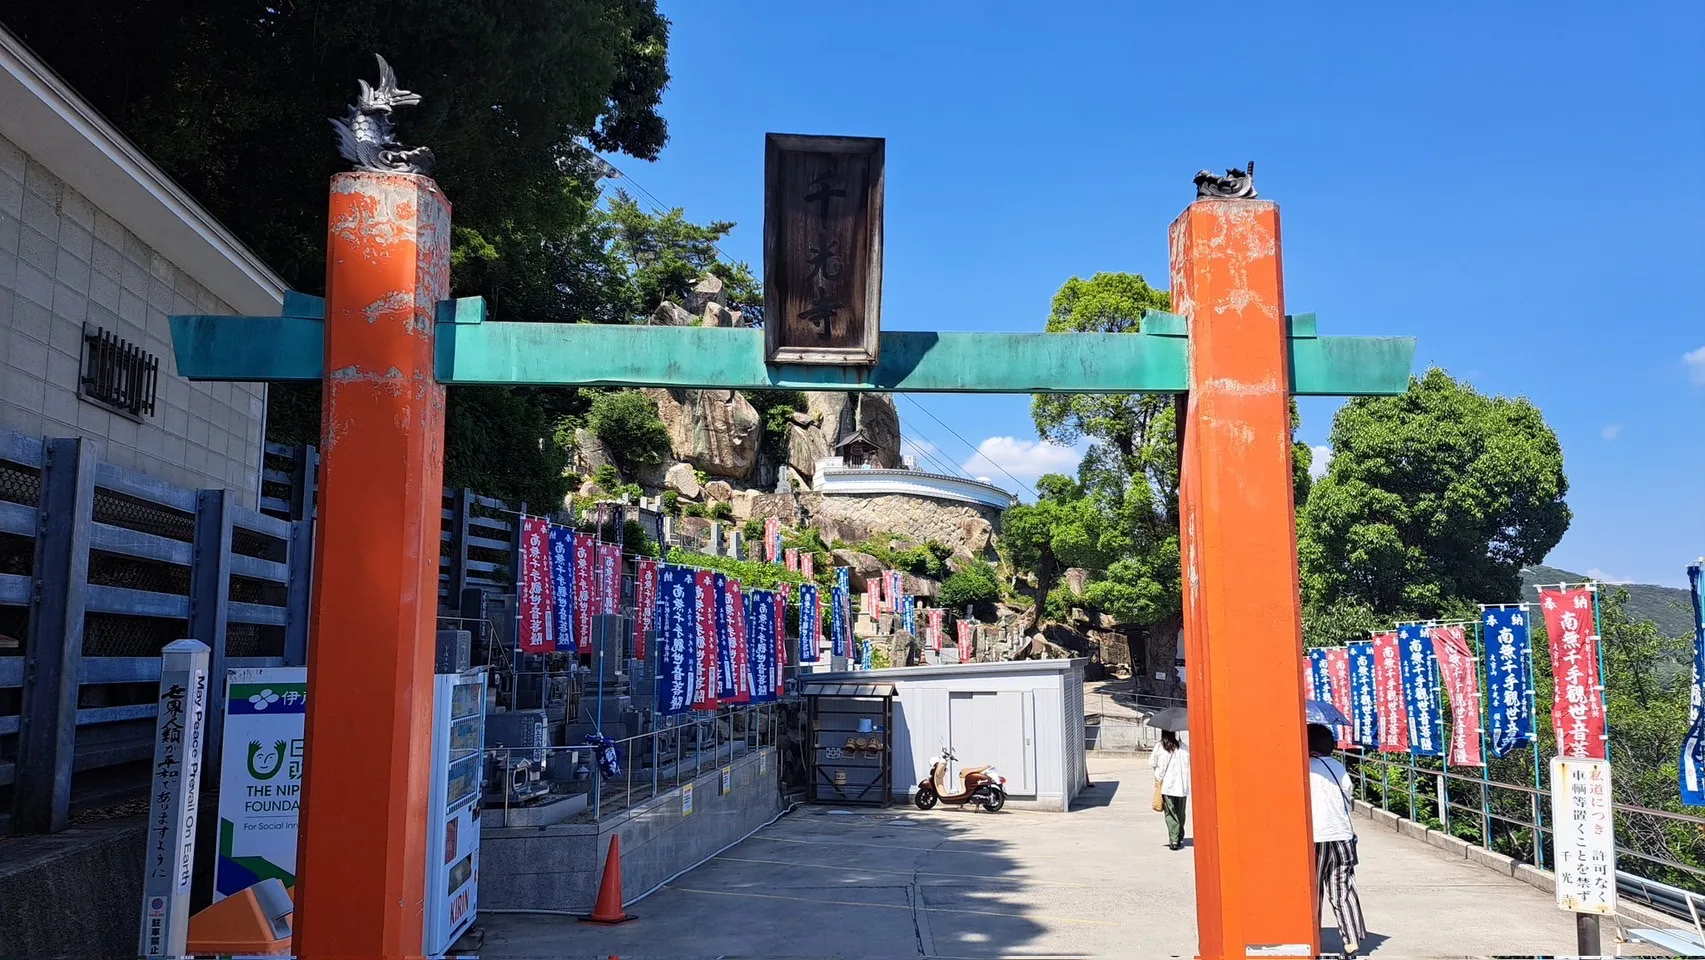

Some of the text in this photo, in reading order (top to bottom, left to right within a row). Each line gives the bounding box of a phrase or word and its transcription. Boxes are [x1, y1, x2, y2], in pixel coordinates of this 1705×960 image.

[797, 168, 847, 342] 千光寺
[1485, 613, 1524, 628] 奉 納
[1543, 595, 1588, 611] 奉 納
[1400, 630, 1409, 640] 奉
[1409, 639, 1433, 751] 南無千手観世音菩薩
[152, 684, 186, 878] 世界人類が平和でありますように
[181, 675, 206, 886] May Peace Prevail On Earth
[246, 785, 272, 797] THE
[244, 823, 257, 831] For
[258, 822, 284, 830] Social
[1589, 770, 1608, 903] 私道につき 許可なく
[1560, 850, 1574, 906] 千光寺
[449, 887, 470, 927] KIRIN
